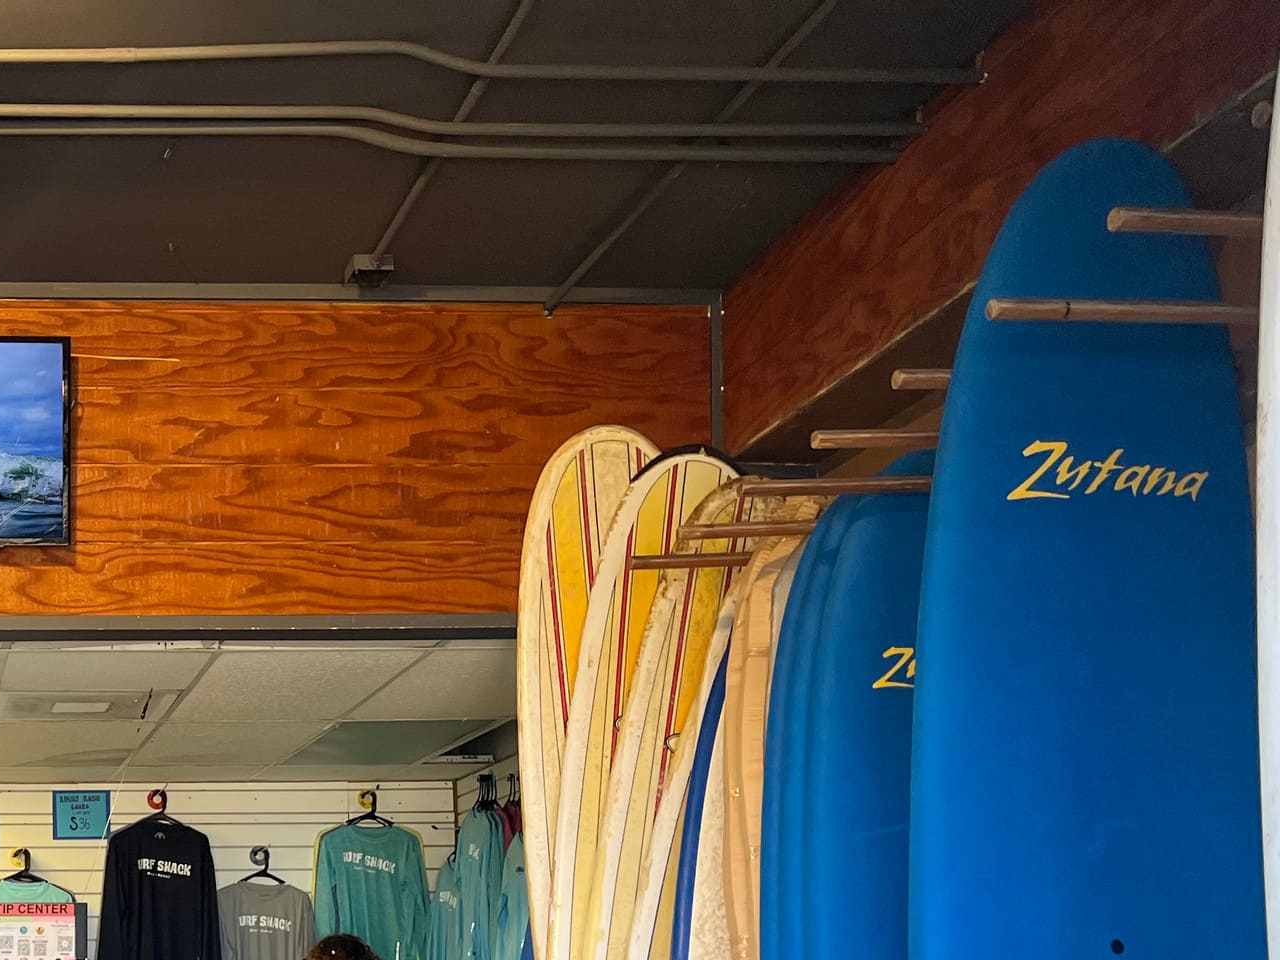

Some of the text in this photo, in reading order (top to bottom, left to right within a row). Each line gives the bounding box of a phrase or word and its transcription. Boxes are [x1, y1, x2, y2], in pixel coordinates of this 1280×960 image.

[1006, 439, 1209, 502] Zutana
[137, 858, 156, 870] URF
[157, 860, 192, 877] SHACK
[364, 854, 396, 875] SHACK
[18, 903, 68, 914] CENTER
[239, 914, 292, 932] URF SHACK
